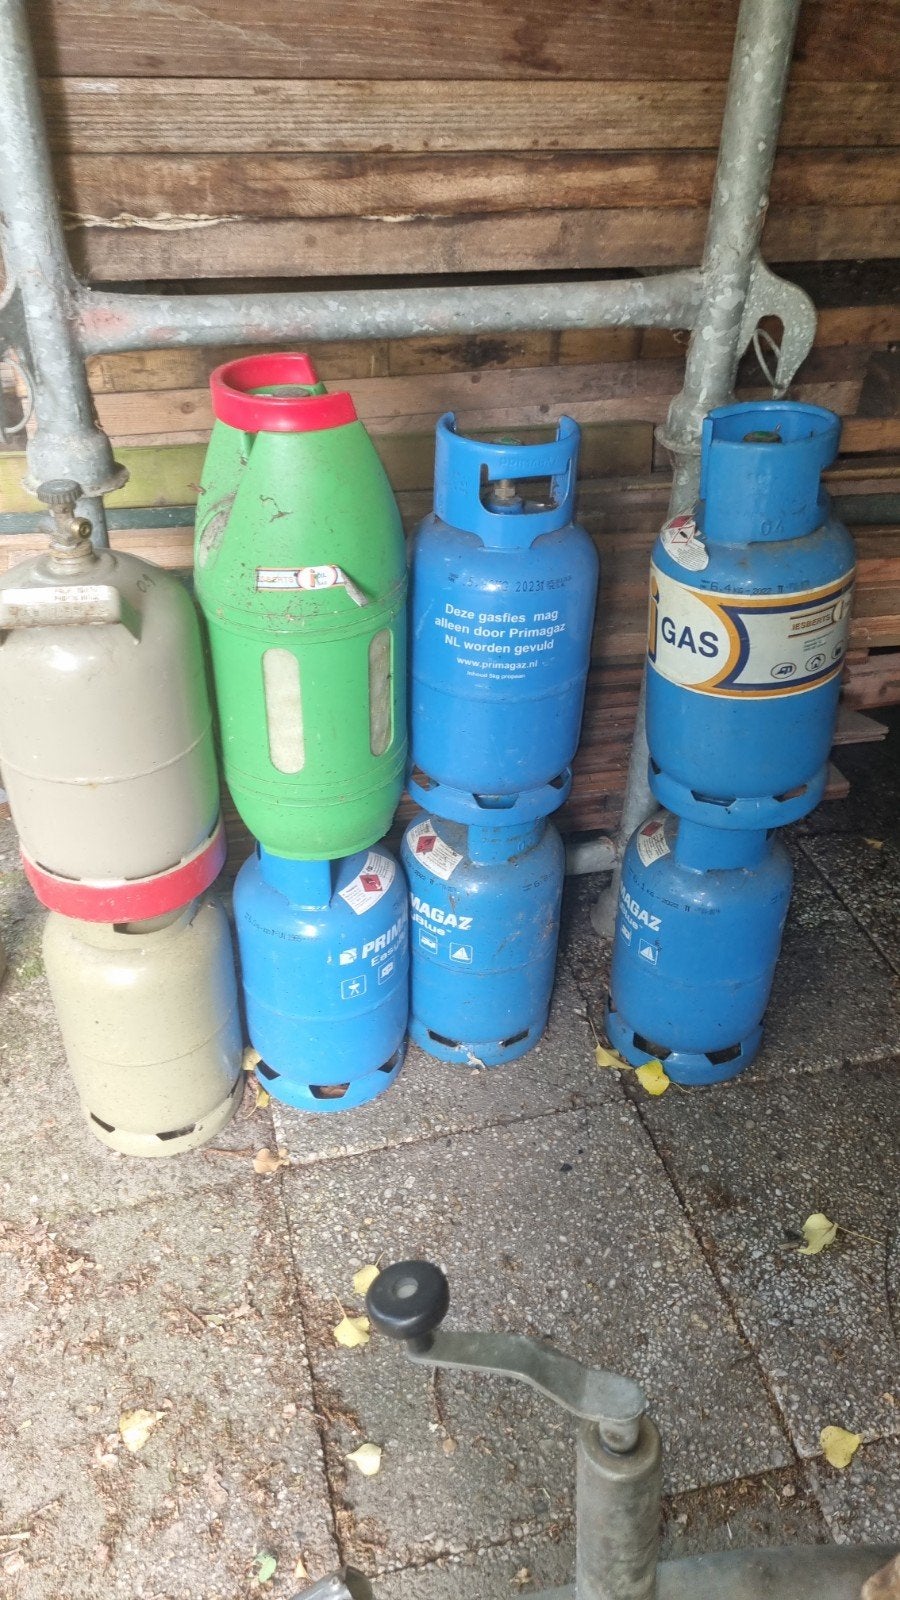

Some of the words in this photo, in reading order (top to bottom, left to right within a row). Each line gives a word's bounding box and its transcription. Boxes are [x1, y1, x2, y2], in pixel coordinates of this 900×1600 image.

[445, 603, 475, 620] Deze
[533, 610, 559, 622] mag
[434, 617, 470, 634] alleen
[473, 626, 506, 638] door
[509, 623, 566, 638] Primagaz
[661, 616, 719, 658] GAS
[444, 634, 461, 648] NL
[463, 640, 511, 654] worden
[514, 638, 555, 656] gevuld
[456, 657, 538, 671] www.primagaz.nl
[362, 914, 405, 959] PRIM
